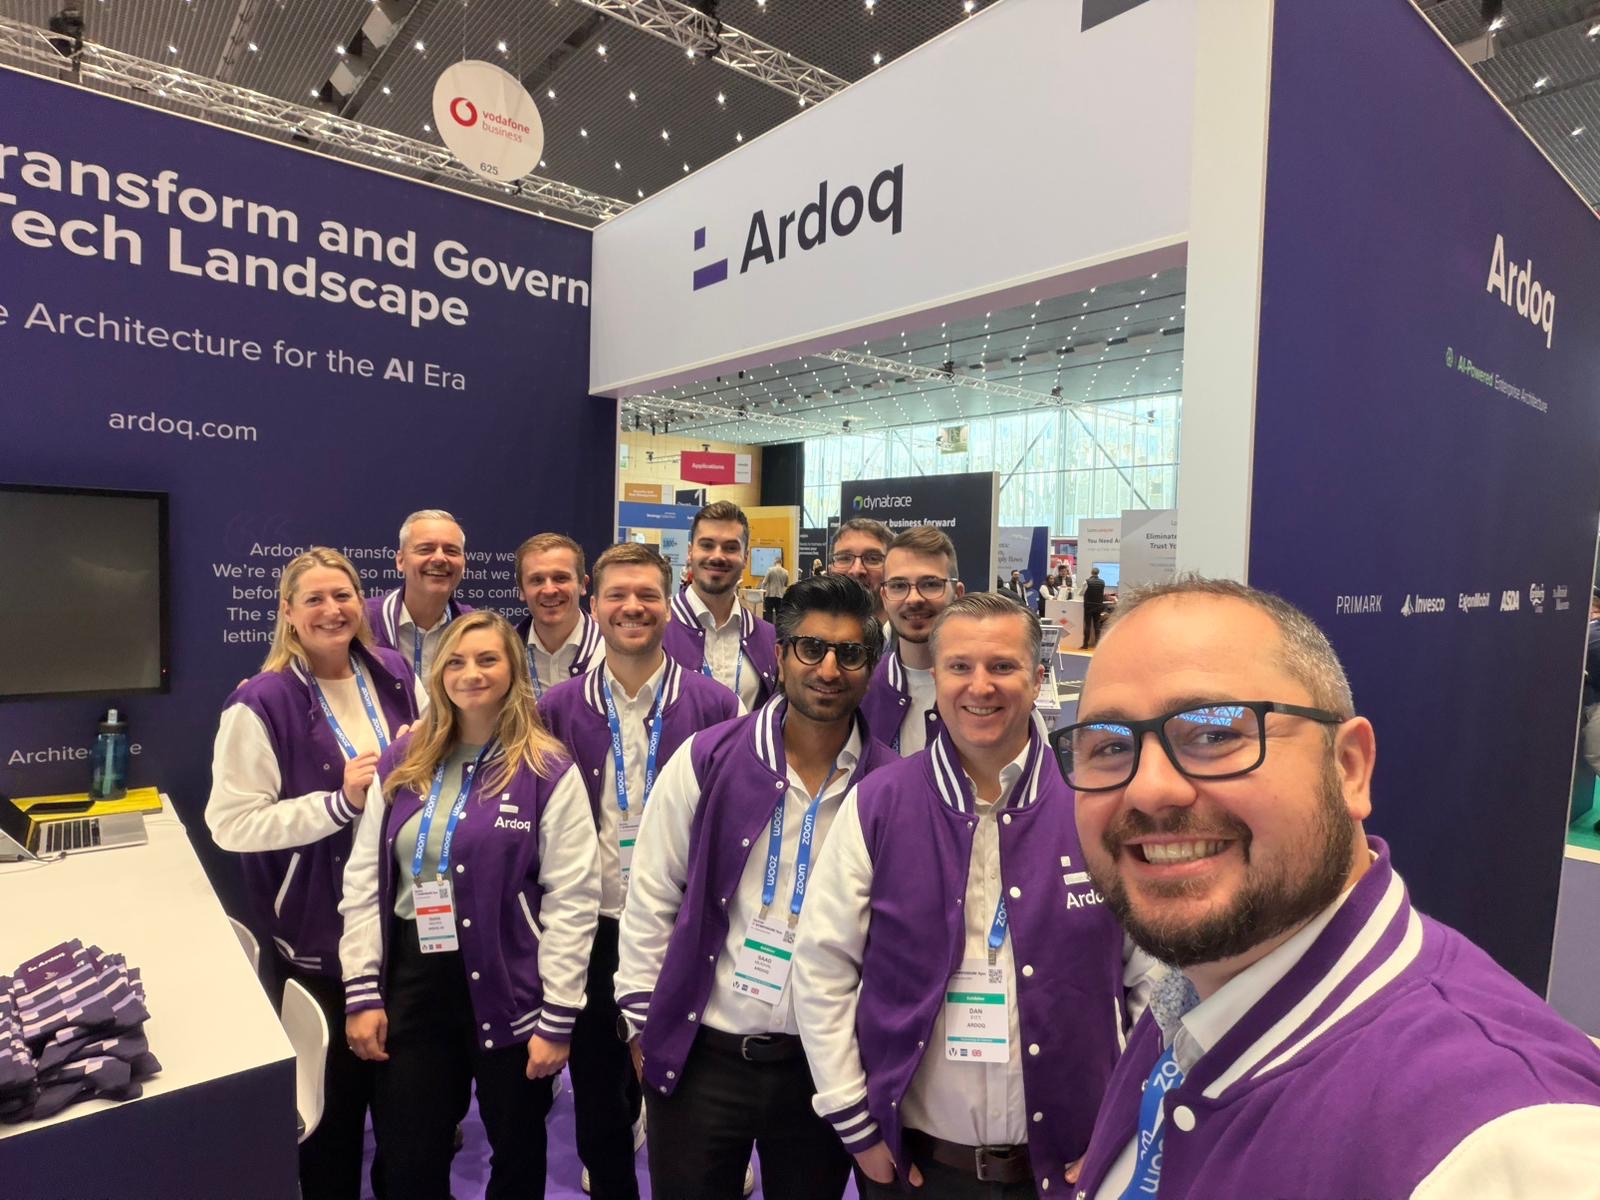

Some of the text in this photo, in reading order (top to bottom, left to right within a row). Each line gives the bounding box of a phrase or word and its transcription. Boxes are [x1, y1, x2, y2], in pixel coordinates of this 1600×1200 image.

[482, 110, 530, 135] vodafone
[482, 121, 523, 143] business
[480, 162, 499, 176] 625
[739, 163, 904, 275] Ardoq
[319, 221, 416, 270] and
[433, 240, 590, 307] Govern
[169, 227, 470, 328] Landscape
[1486, 233, 1556, 349] Ardoq
[24, 303, 262, 362] Architecture
[273, 339, 318, 370] for
[325, 350, 375, 377] the
[383, 357, 414, 384] AI
[424, 363, 466, 391] Era
[108, 411, 257, 442] ardoq.com
[863, 493, 912, 511] dynatrace
[889, 518, 921, 527] business
[465, 551, 492, 564] way
[495, 552, 516, 562] we
[360, 570, 378, 579] so
[462, 568, 487, 580] that
[491, 571, 510, 580] we
[453, 588, 464, 598] is
[468, 589, 484, 598] so
[1336, 595, 1383, 614] PRIMARK
[1415, 593, 1446, 614] Invesco
[227, 607, 262, 621] The
[372, 717, 384, 739] zoom
[605, 698, 625, 795] zoom zoom zoom
[649, 731, 658, 756] zoom
[424, 794, 437, 819] zoom
[443, 792, 466, 857] zoom zoom
[494, 815, 531, 832] Ardoq
[415, 832, 426, 859] zoom
[767, 806, 783, 886] zoom zoom
[796, 814, 813, 895] zoom zoom
